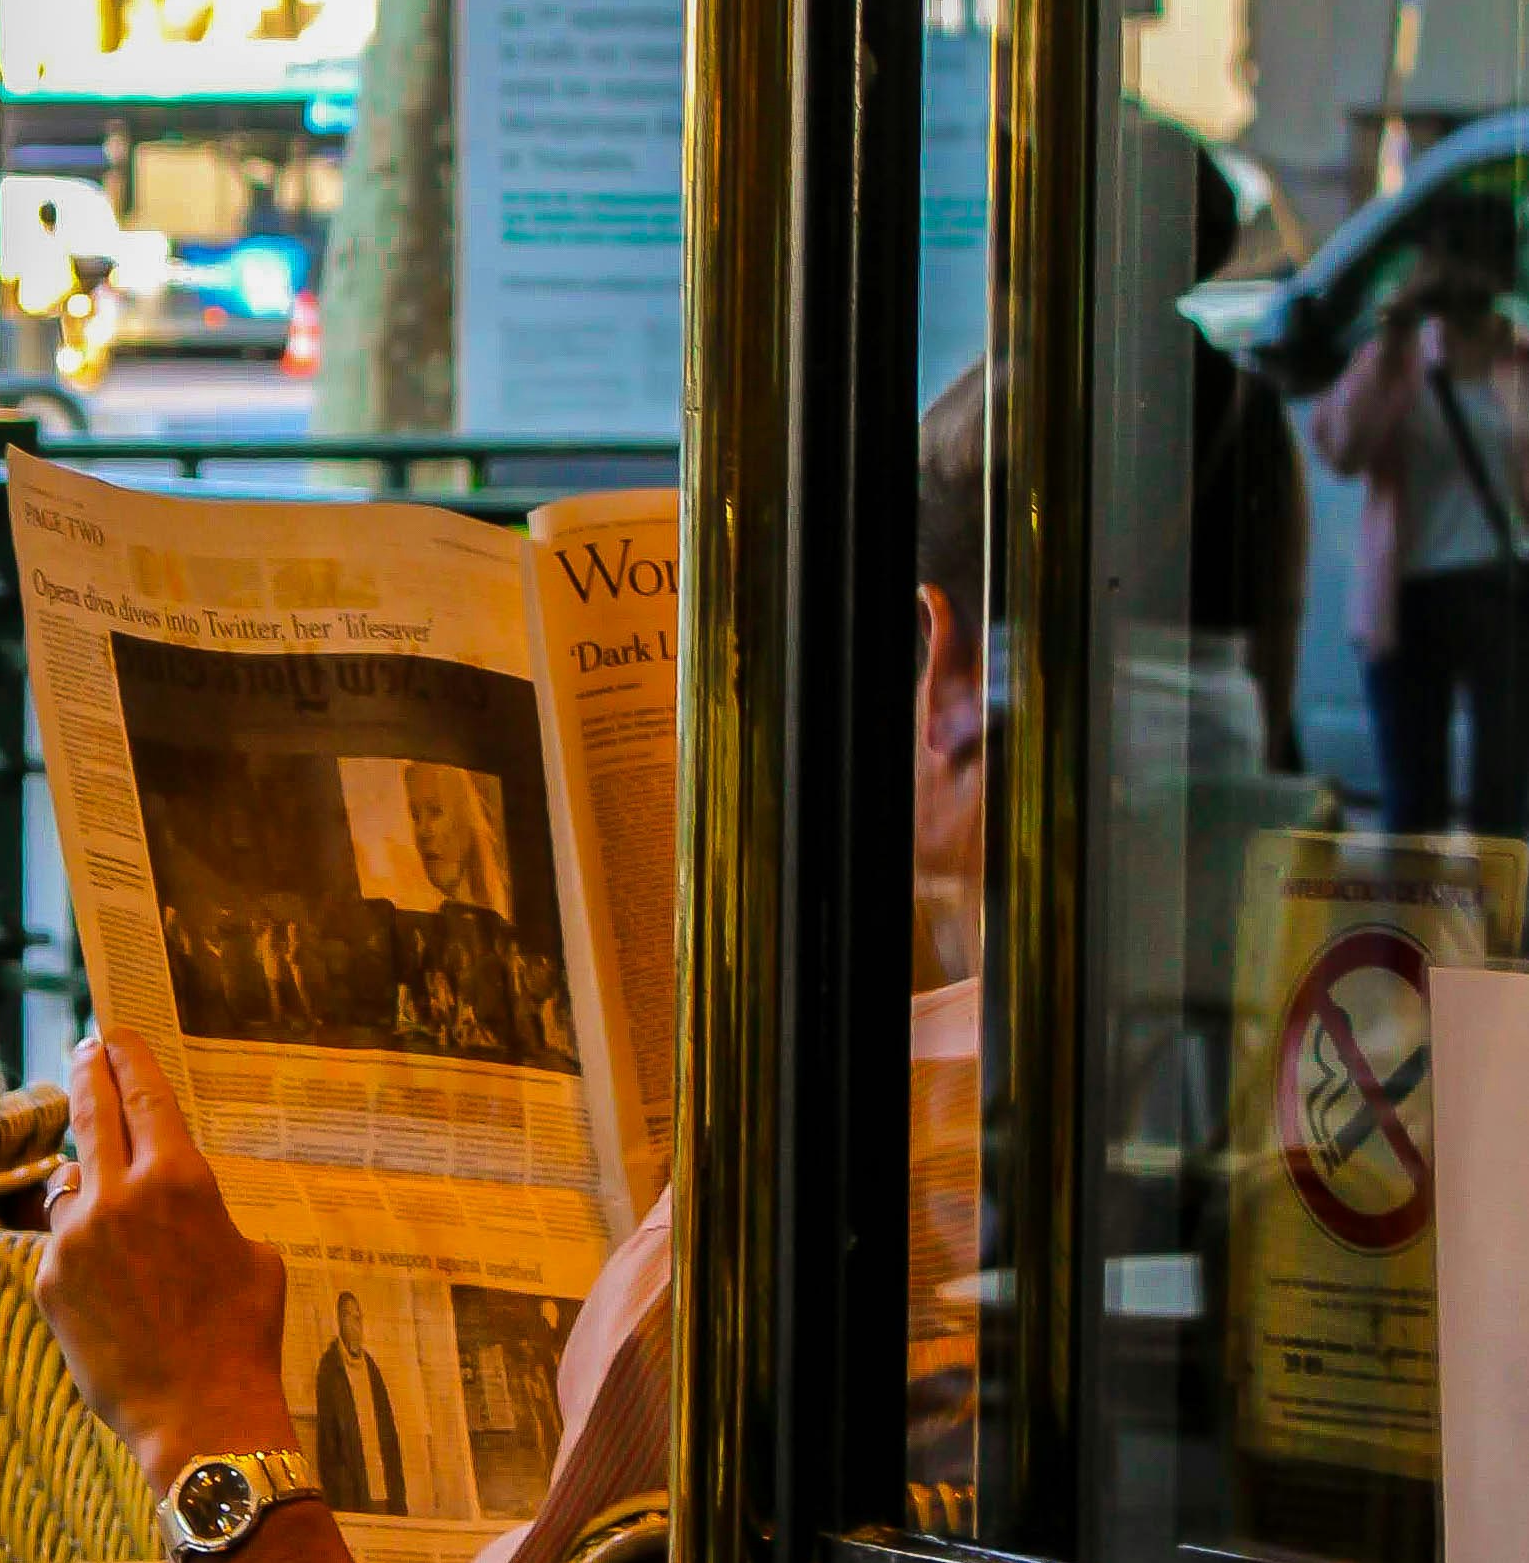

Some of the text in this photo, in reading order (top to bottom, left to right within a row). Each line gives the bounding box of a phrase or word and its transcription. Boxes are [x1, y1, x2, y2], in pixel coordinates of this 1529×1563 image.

[65, 515, 105, 547] TWO
[118, 593, 162, 629] dives
[164, 606, 201, 636] into
[202, 608, 285, 642] Twitter,
[290, 613, 333, 640] her
